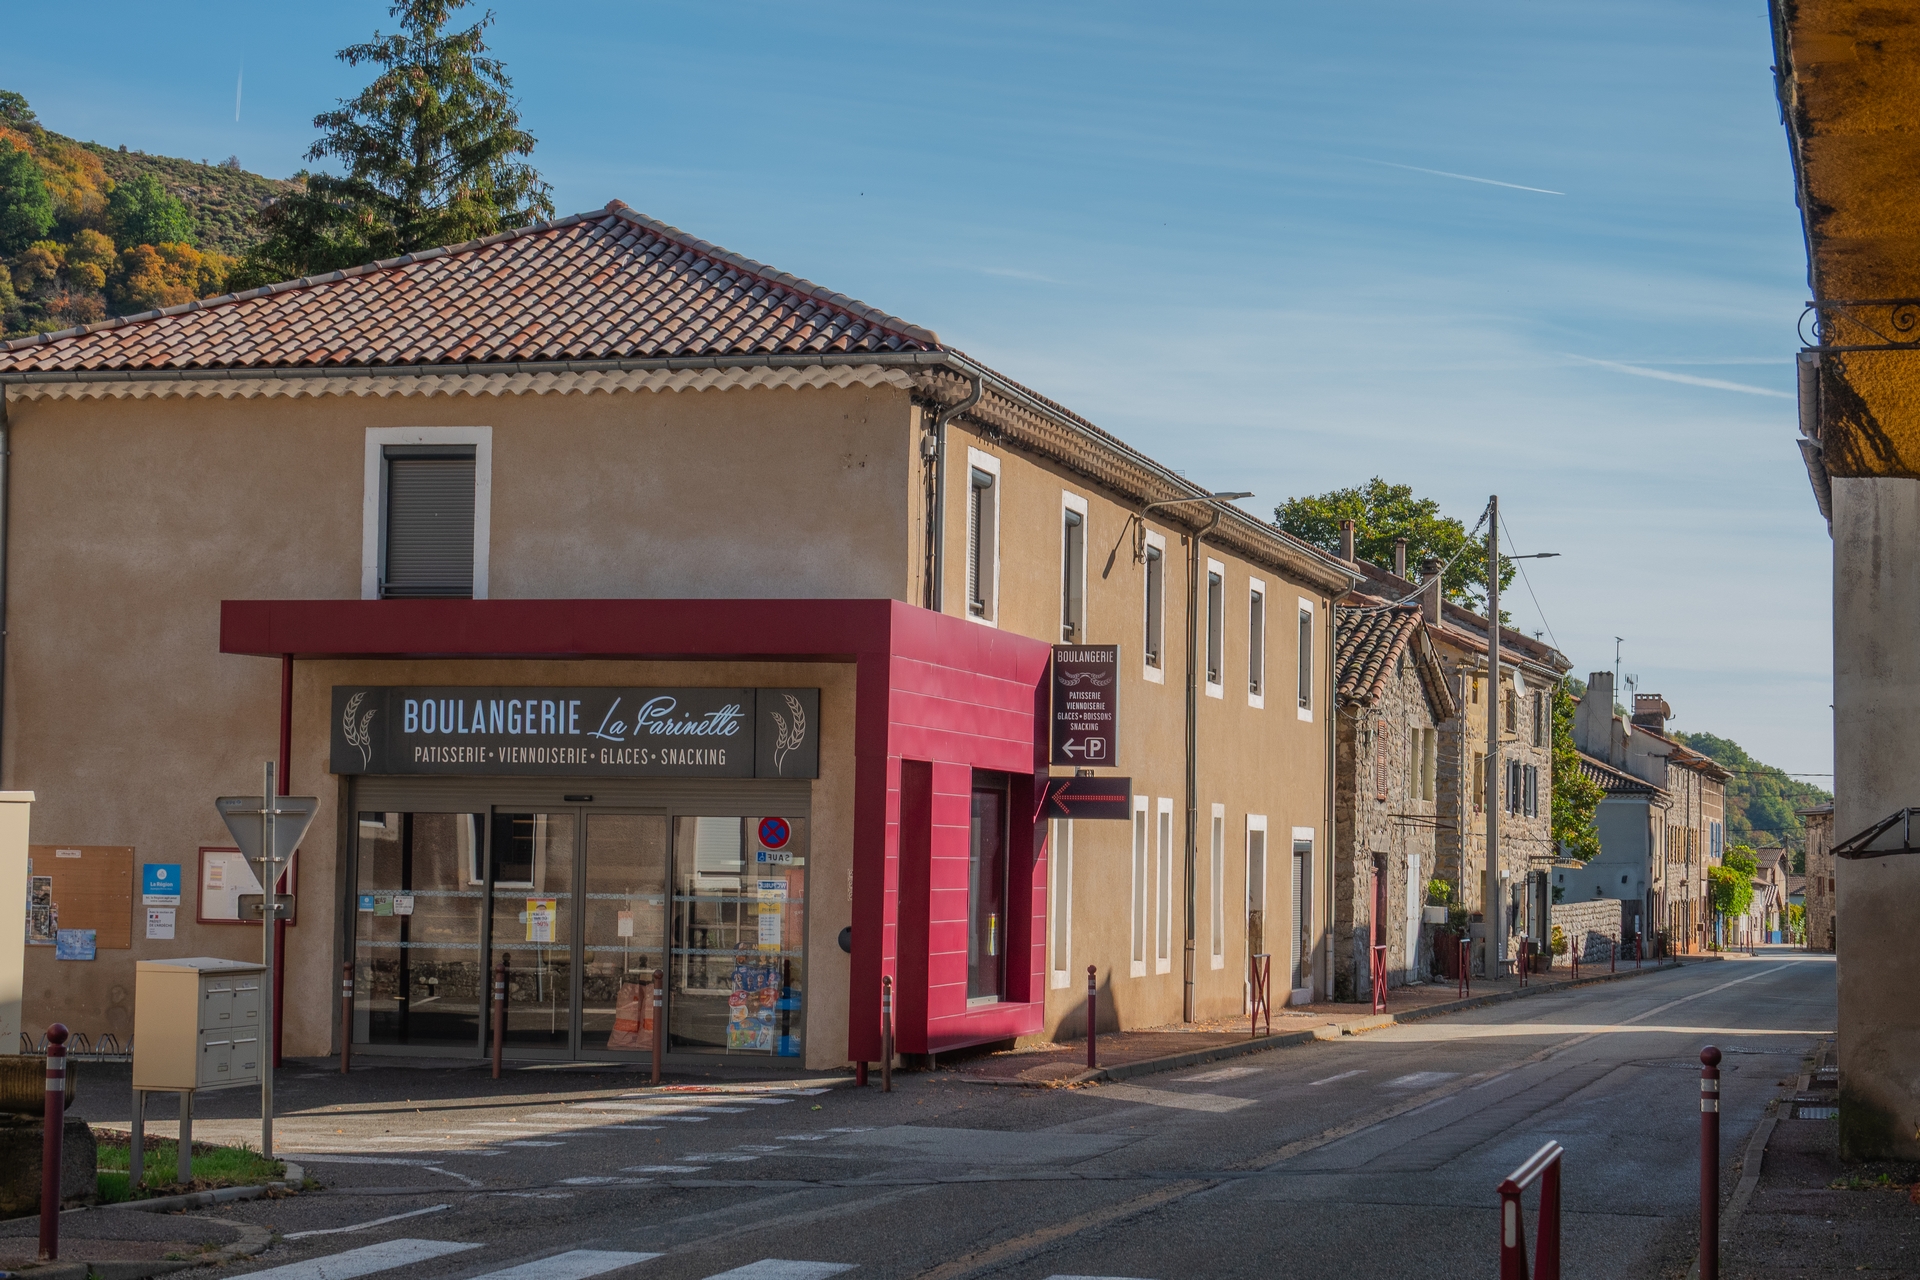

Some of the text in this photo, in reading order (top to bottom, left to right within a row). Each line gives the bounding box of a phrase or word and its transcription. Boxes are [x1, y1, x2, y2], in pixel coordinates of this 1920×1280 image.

[1057, 651, 1114, 663] BOULANGERIE
[1069, 691, 1101, 700] PATISSERIE
[1066, 702, 1106, 710] VIENNOISERIE
[404, 699, 581, 735] BOULANGERIE
[586, 696, 628, 742] La
[1057, 712, 1112, 721] GLACES BOISSONS
[1070, 722, 1099, 731] SNACKING
[414, 746, 726, 765] PATISSERIE VIENNOISERIE GLACES SNACKING
